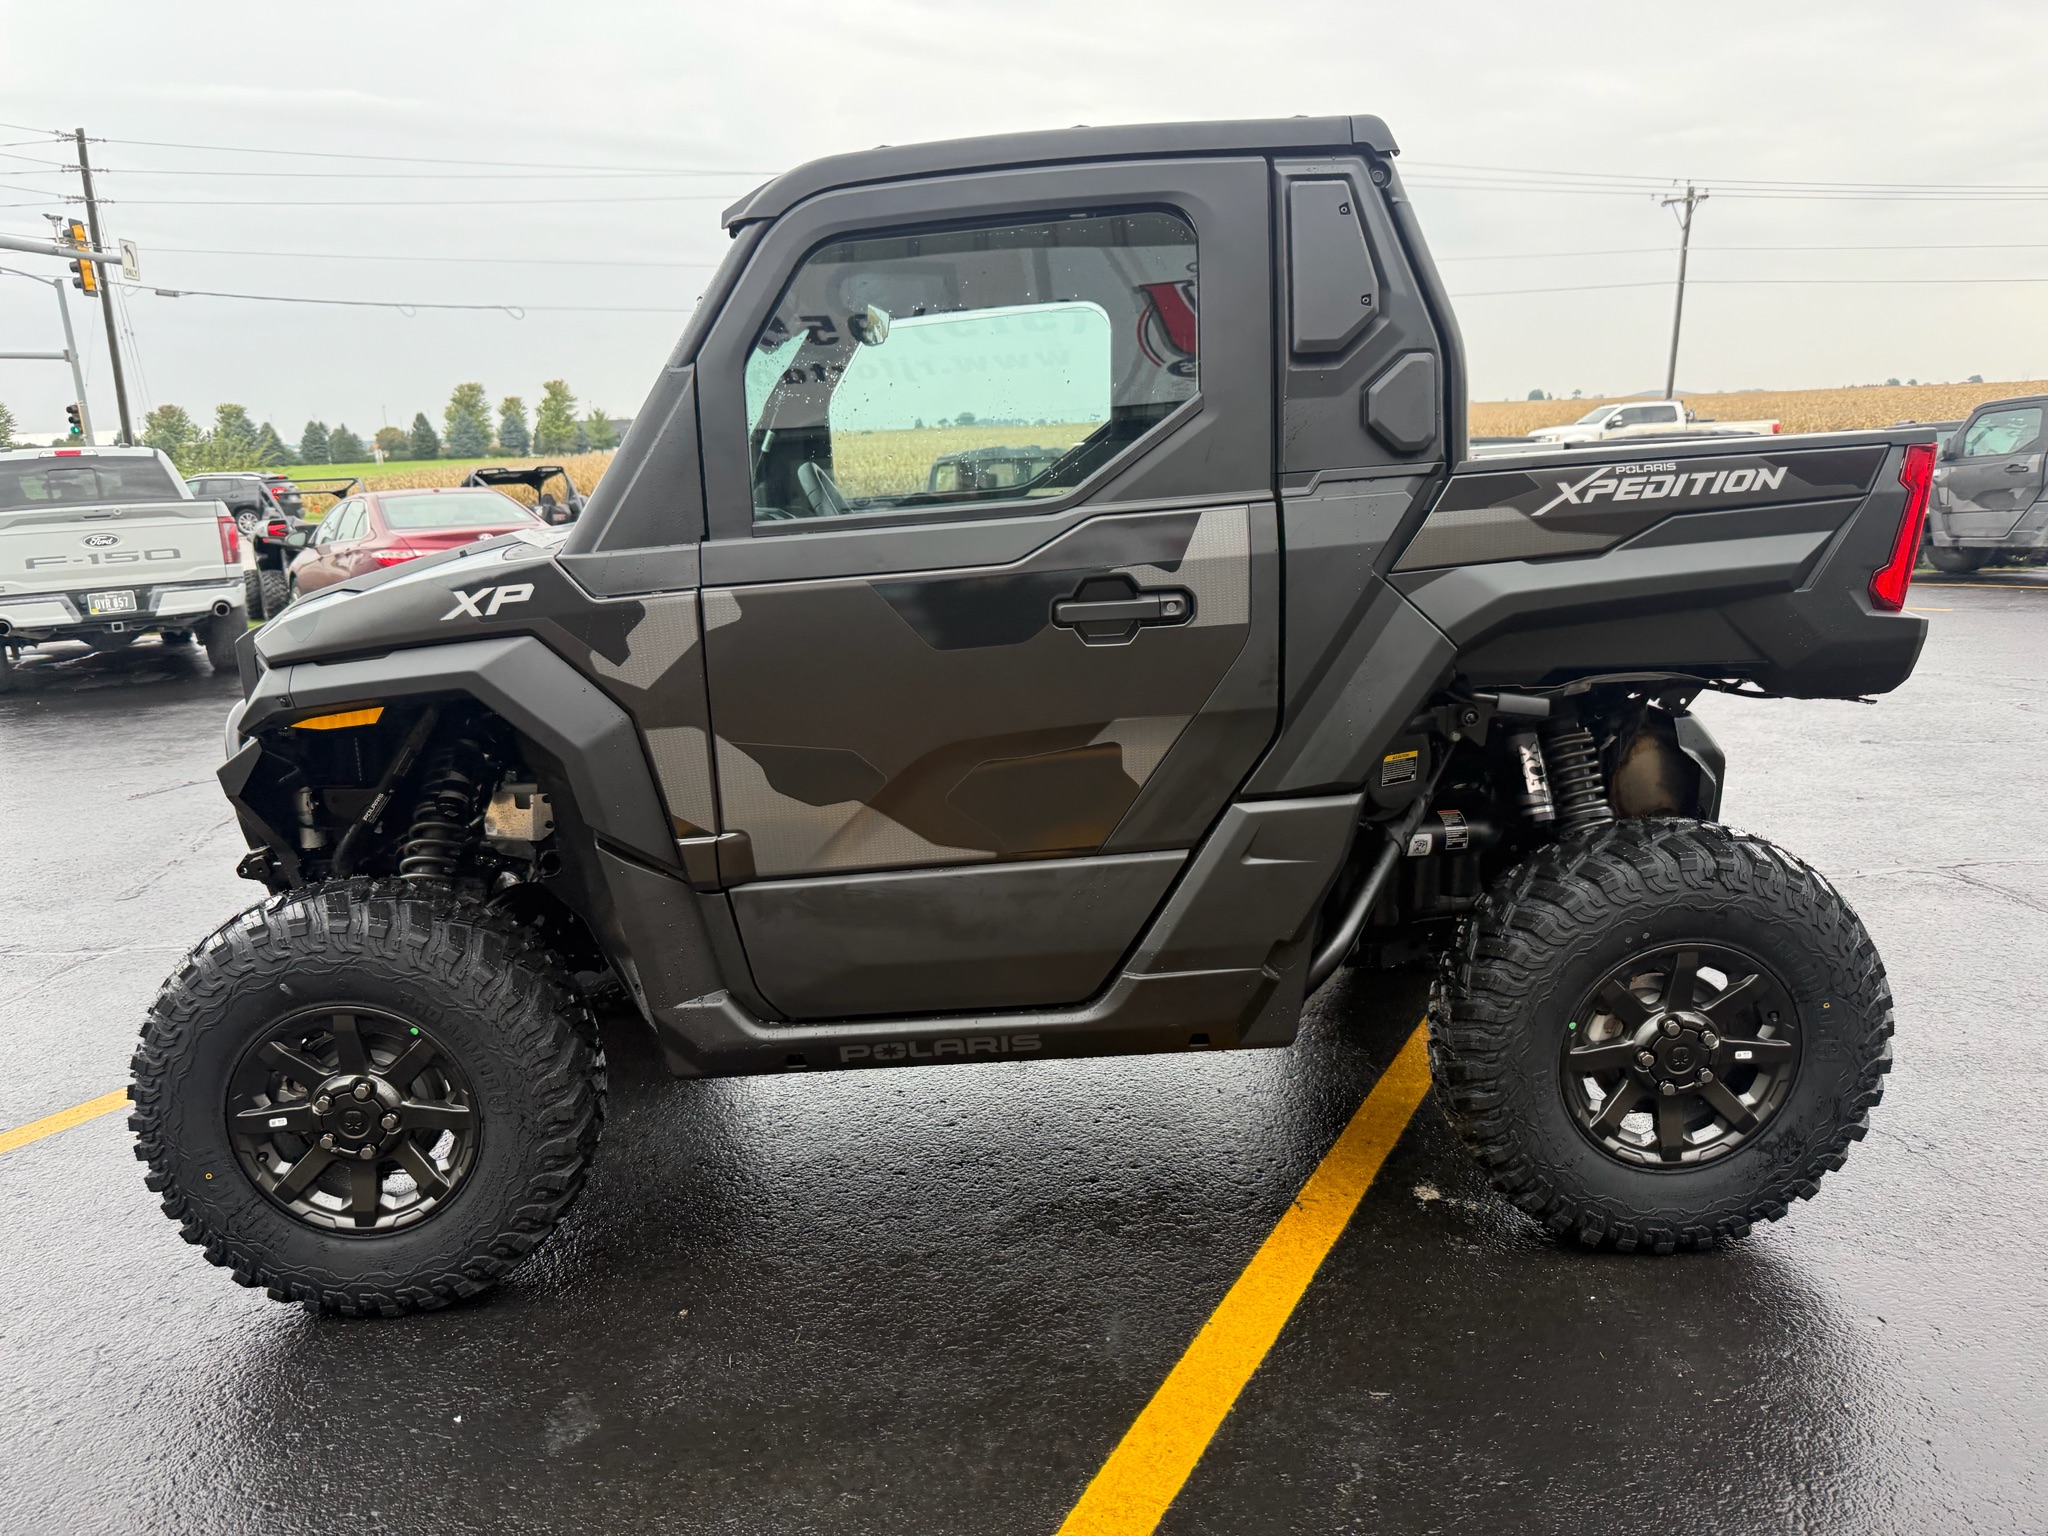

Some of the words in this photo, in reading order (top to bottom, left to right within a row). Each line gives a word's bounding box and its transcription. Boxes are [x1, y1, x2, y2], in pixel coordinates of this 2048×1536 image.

[125, 267, 138, 277] ONLY
[1615, 462, 1677, 475] POLARIS
[1530, 466, 1789, 516] XPEDITION
[25, 548, 182, 570] F-150
[440, 583, 535, 621] XP
[1518, 742, 1547, 794] FOX
[363, 792, 385, 821] POLARIS
[839, 1033, 1043, 1063] POLARIS
